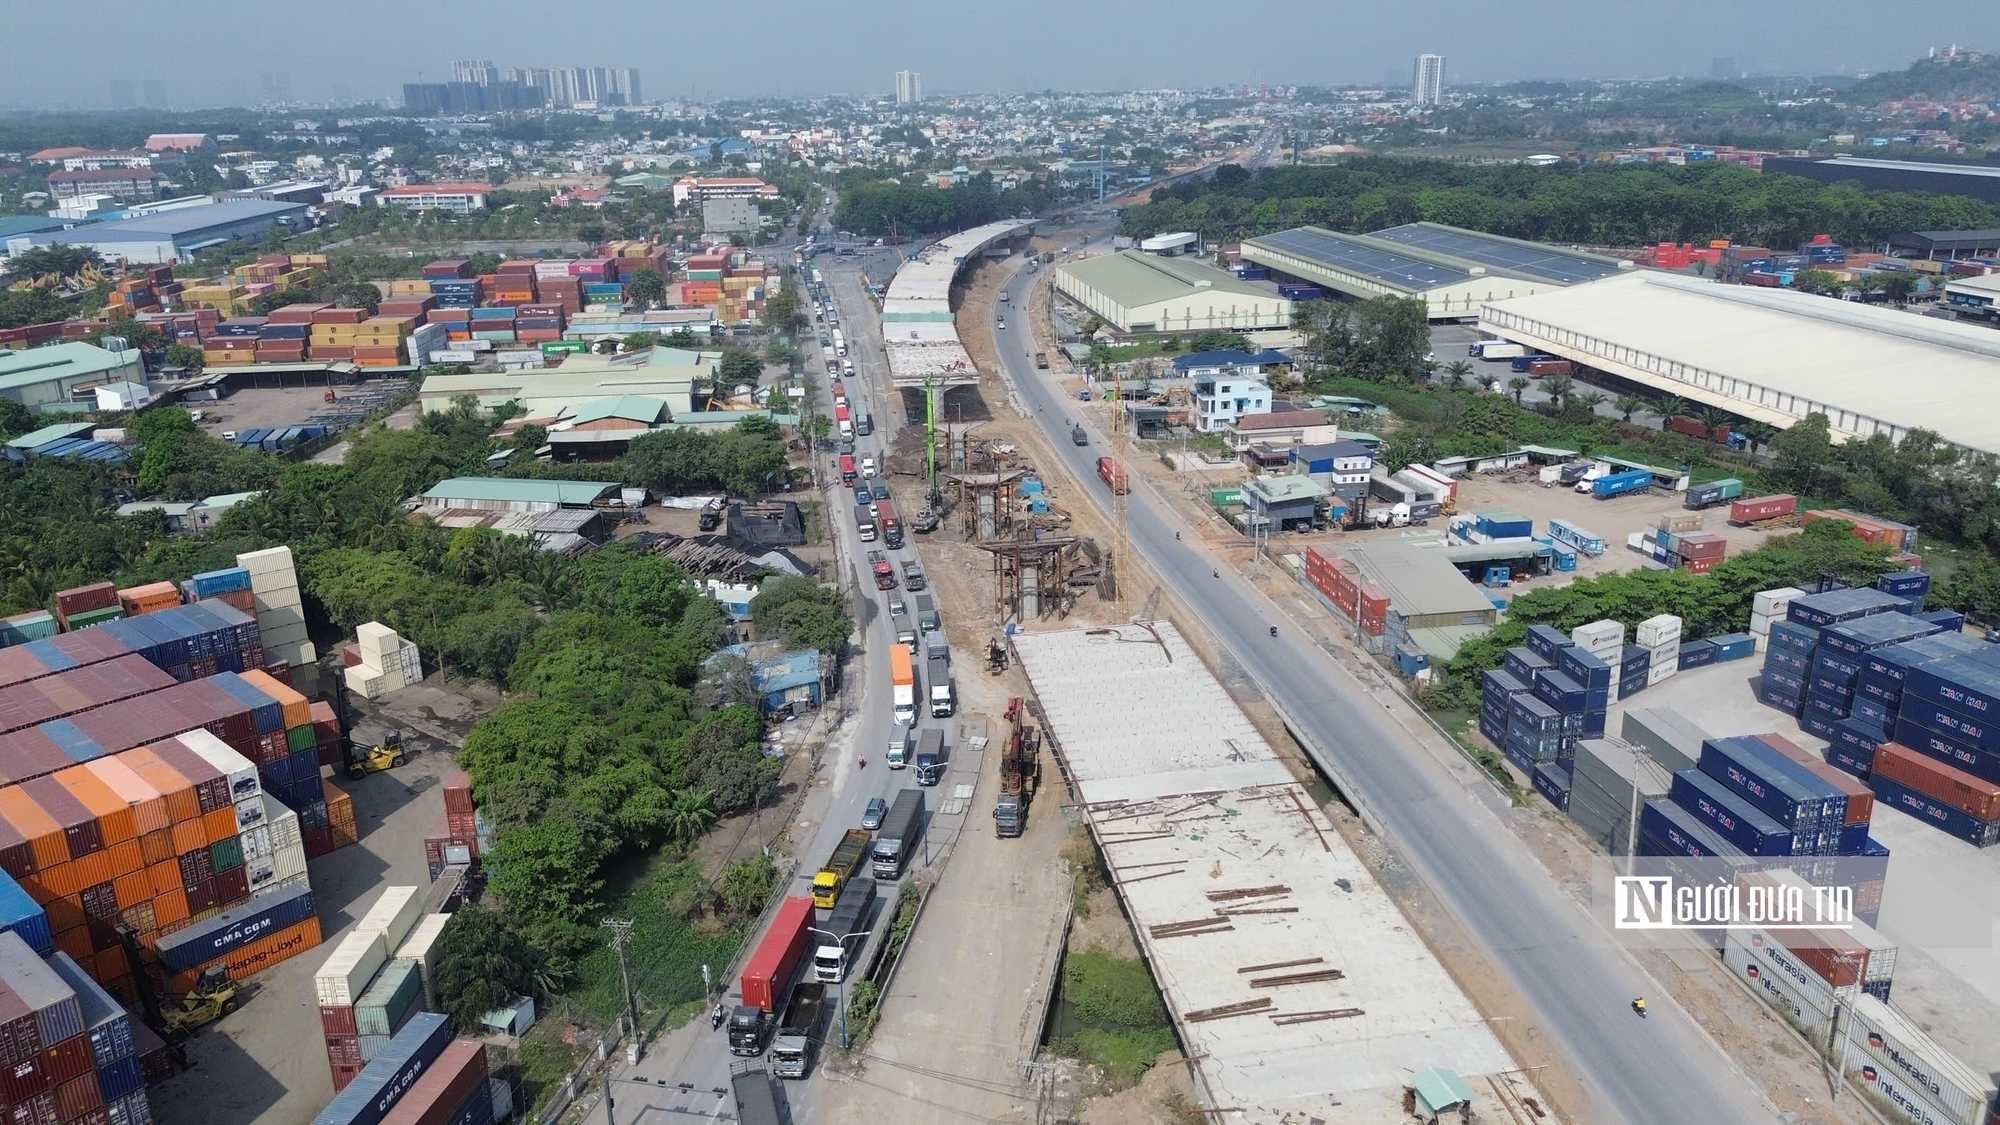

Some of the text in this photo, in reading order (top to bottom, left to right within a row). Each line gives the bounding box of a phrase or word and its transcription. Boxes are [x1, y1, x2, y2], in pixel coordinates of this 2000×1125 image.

[1940, 686, 1988, 710] WAN HAI
[1936, 712, 1982, 738] WAN HAI
[1930, 738, 1976, 764] WAN HAI
[1728, 766, 1766, 798] WAN HAI
[1699, 798, 1736, 830] WAN HAI
[1902, 794, 1948, 820] WAN HAI
[1668, 828, 1704, 862] WAN HAI
[214, 918, 271, 948] CMA CGM
[226, 934, 302, 974] Hapag-Lloyd
[1763, 940, 1807, 985] Interasia
[1758, 972, 1800, 1017] Interasia
[1883, 1042, 1940, 1096] Interasia
[380, 1061, 422, 1112] CMA CGM
[1878, 1076, 1934, 1125] Interasia
